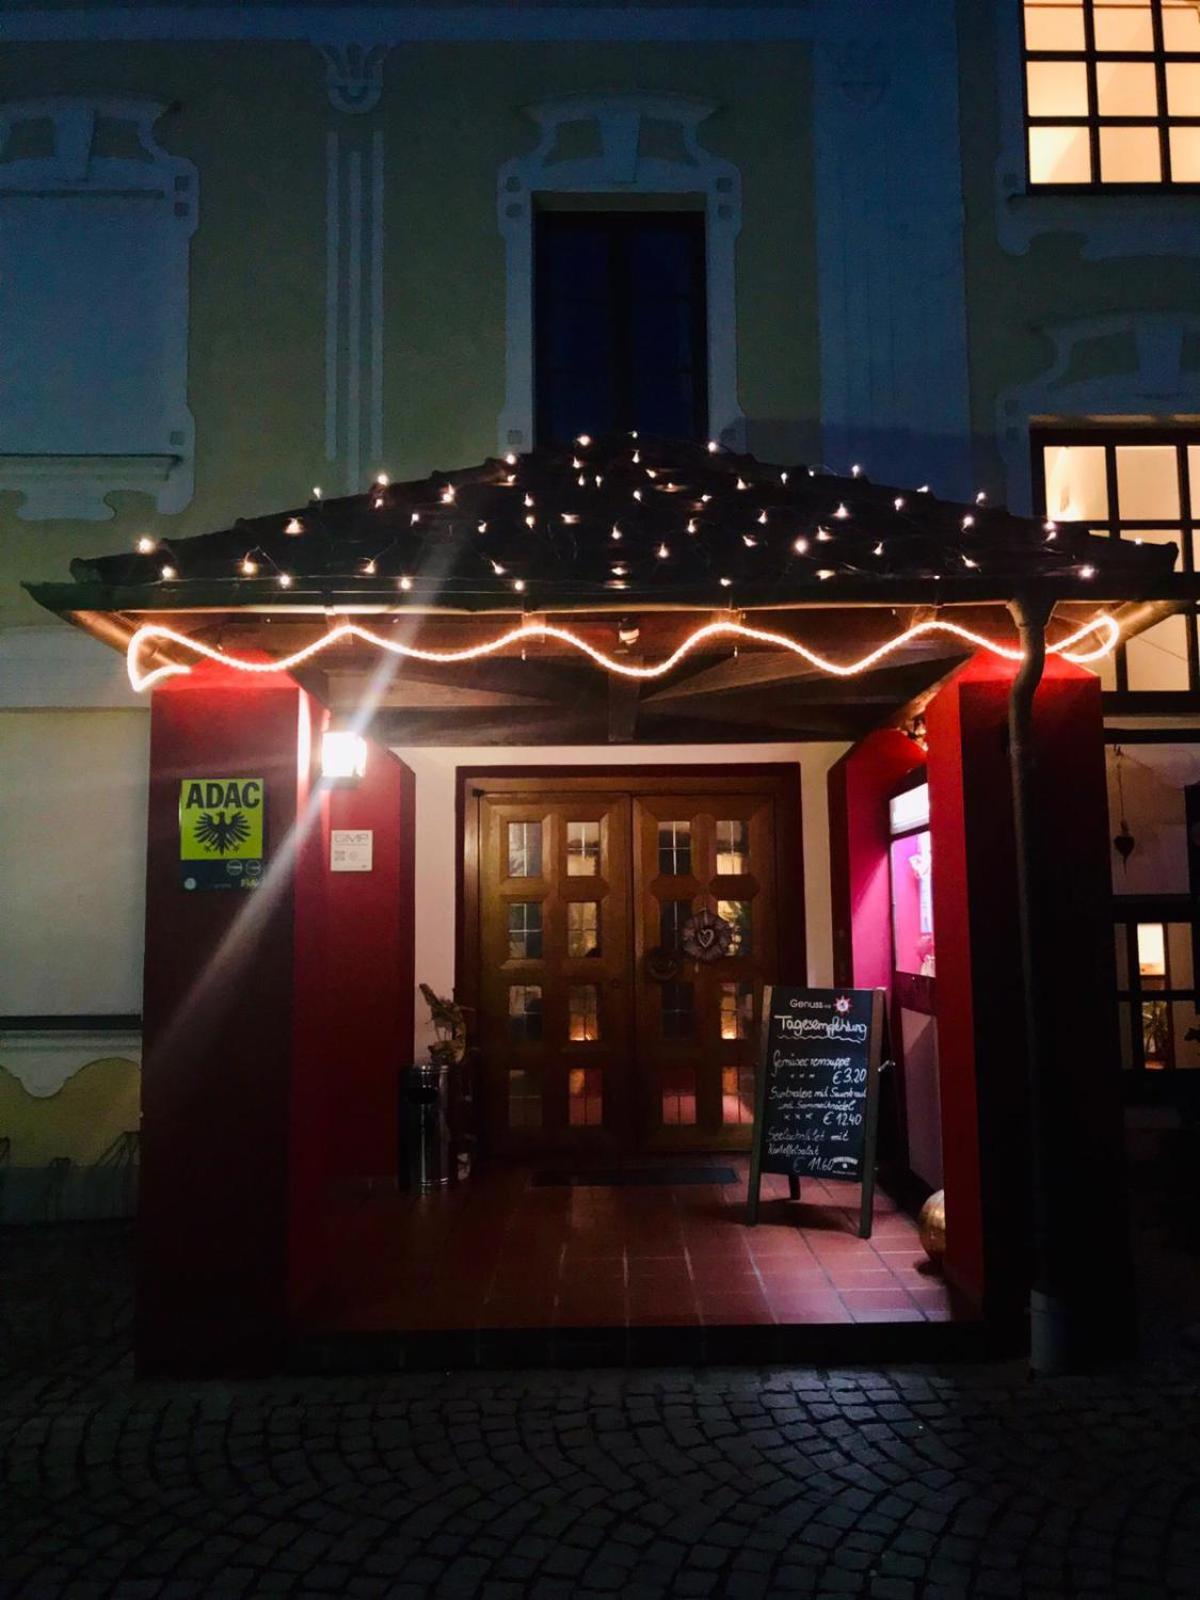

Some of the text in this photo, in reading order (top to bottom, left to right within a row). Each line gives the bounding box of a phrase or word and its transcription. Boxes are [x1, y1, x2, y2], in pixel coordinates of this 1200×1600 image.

[186, 782, 260, 809] ADAC
[789, 998, 823, 1009] Genuss
[830, 1129, 849, 1141] mit
